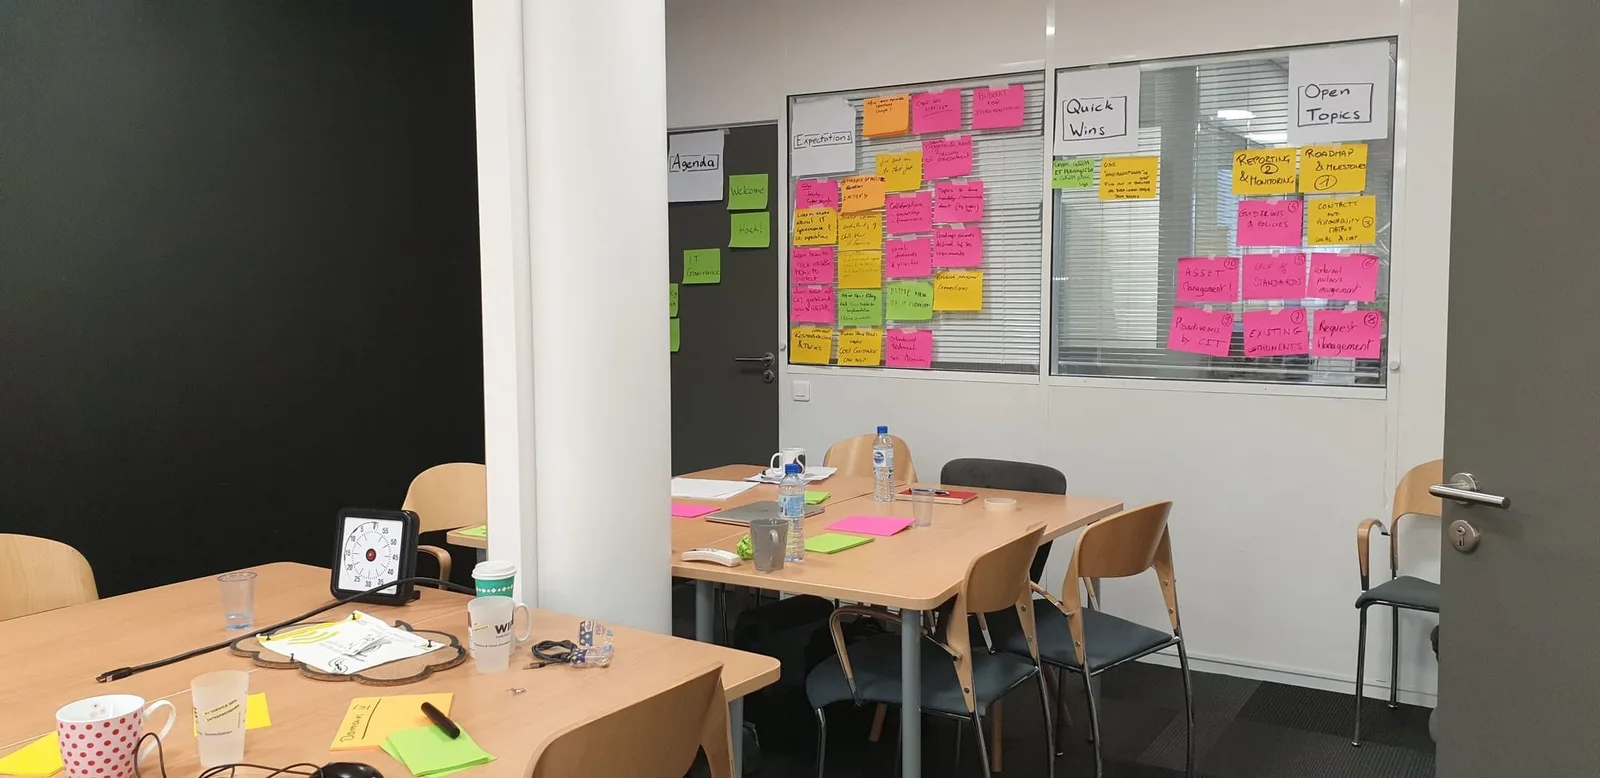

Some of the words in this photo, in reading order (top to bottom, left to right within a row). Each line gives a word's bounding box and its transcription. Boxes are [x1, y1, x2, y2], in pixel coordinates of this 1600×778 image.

[1304, 84, 1350, 101] Open
[1066, 98, 1114, 115] Quick
[1306, 107, 1361, 124] Topics
[1069, 121, 1106, 137] Wins
[796, 133, 852, 147] Expectations
[1304, 148, 1354, 158] ROADMAP
[671, 153, 715, 172] Agenda
[1235, 153, 1291, 167] REPORTING
[1315, 161, 1324, 172] &
[1326, 163, 1367, 171] MILESTONES
[1239, 171, 1250, 184] &
[1249, 175, 1294, 186] MONITORING
[729, 186, 765, 197] Welcome
[1317, 200, 1358, 210] CONTACTS
[1257, 219, 1289, 229] POLICIES
[686, 267, 720, 277] Governance
[1185, 267, 1225, 277] ASSET
[1253, 276, 1303, 287] STANDARDS
[1249, 326, 1303, 338] EXISTING
[1318, 320, 1359, 337] Request
[1181, 335, 1190, 345] by
[1198, 338, 1226, 348] CIT
[1318, 339, 1374, 356] Management
[360, 525, 365, 533] 5
[390, 538, 397, 546] 50
[346, 563, 353, 571] 20
[387, 568, 394, 576] 40
[353, 575, 361, 583] 25
[364, 580, 372, 588] 30
[377, 578, 385, 586] 35
